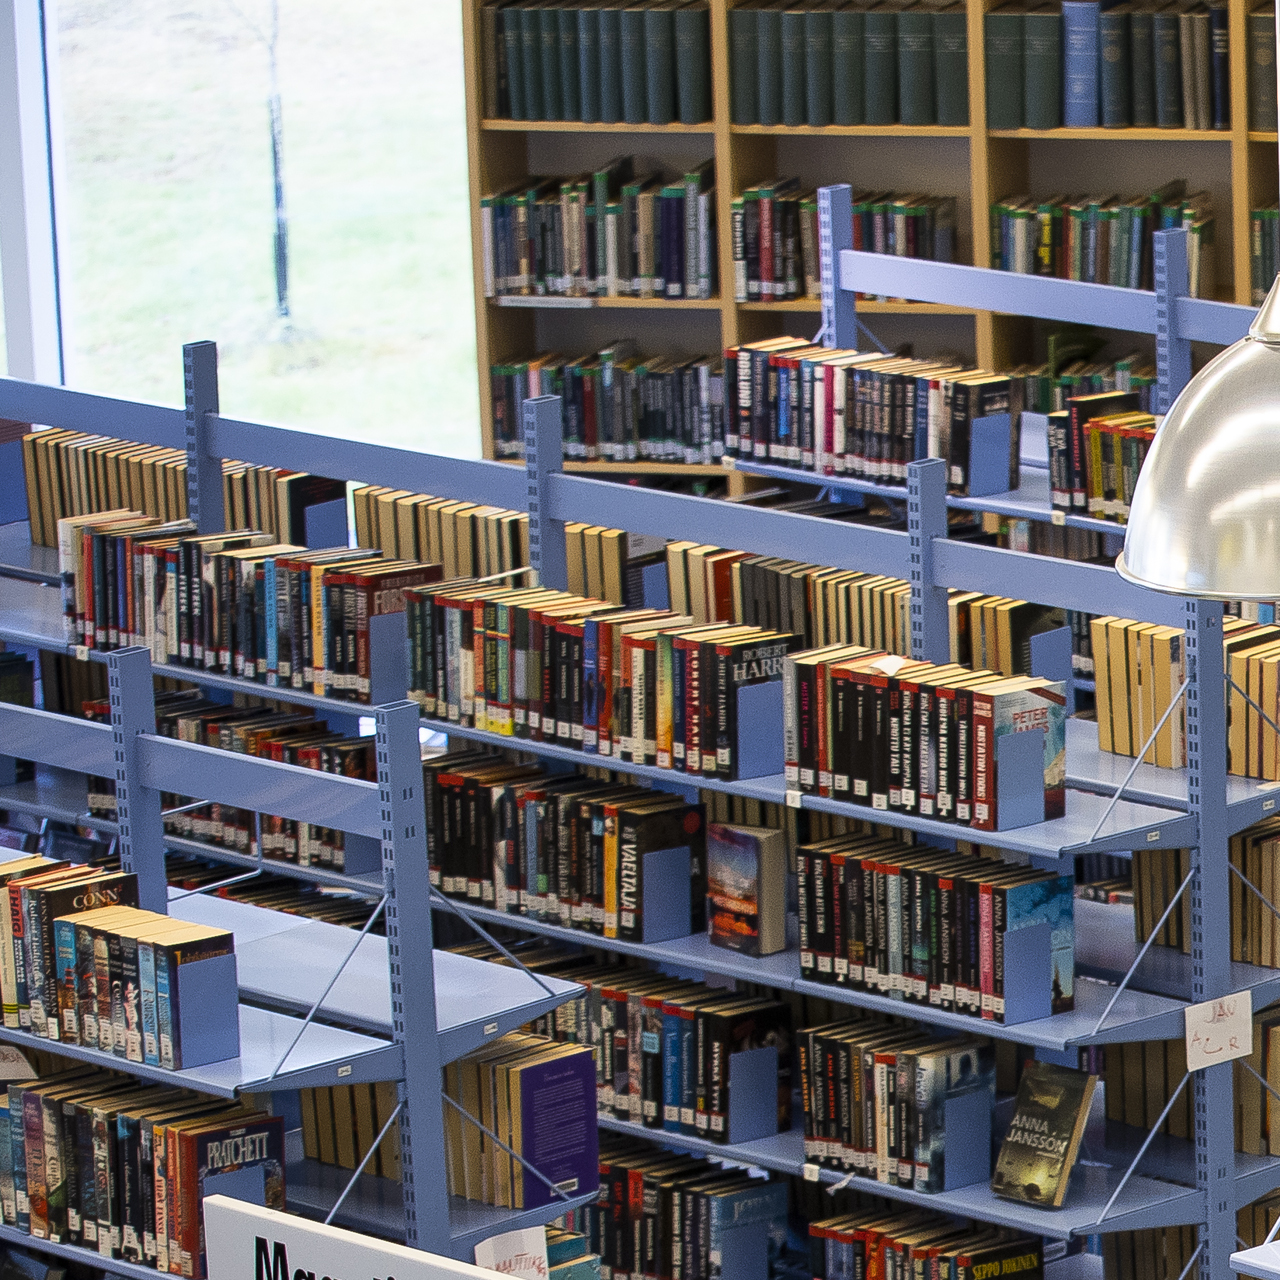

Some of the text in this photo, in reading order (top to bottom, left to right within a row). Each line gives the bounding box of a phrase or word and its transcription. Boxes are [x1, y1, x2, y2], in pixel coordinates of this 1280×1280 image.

[1012, 706, 1048, 724] PETER
[73, 888, 121, 910] CONN
[994, 894, 1003, 929] ANNA
[1010, 1114, 1049, 1133] ANNA
[207, 1131, 269, 1170] PRATCHETT
[972, 1252, 1039, 1280] SEPPO JOKINEN
